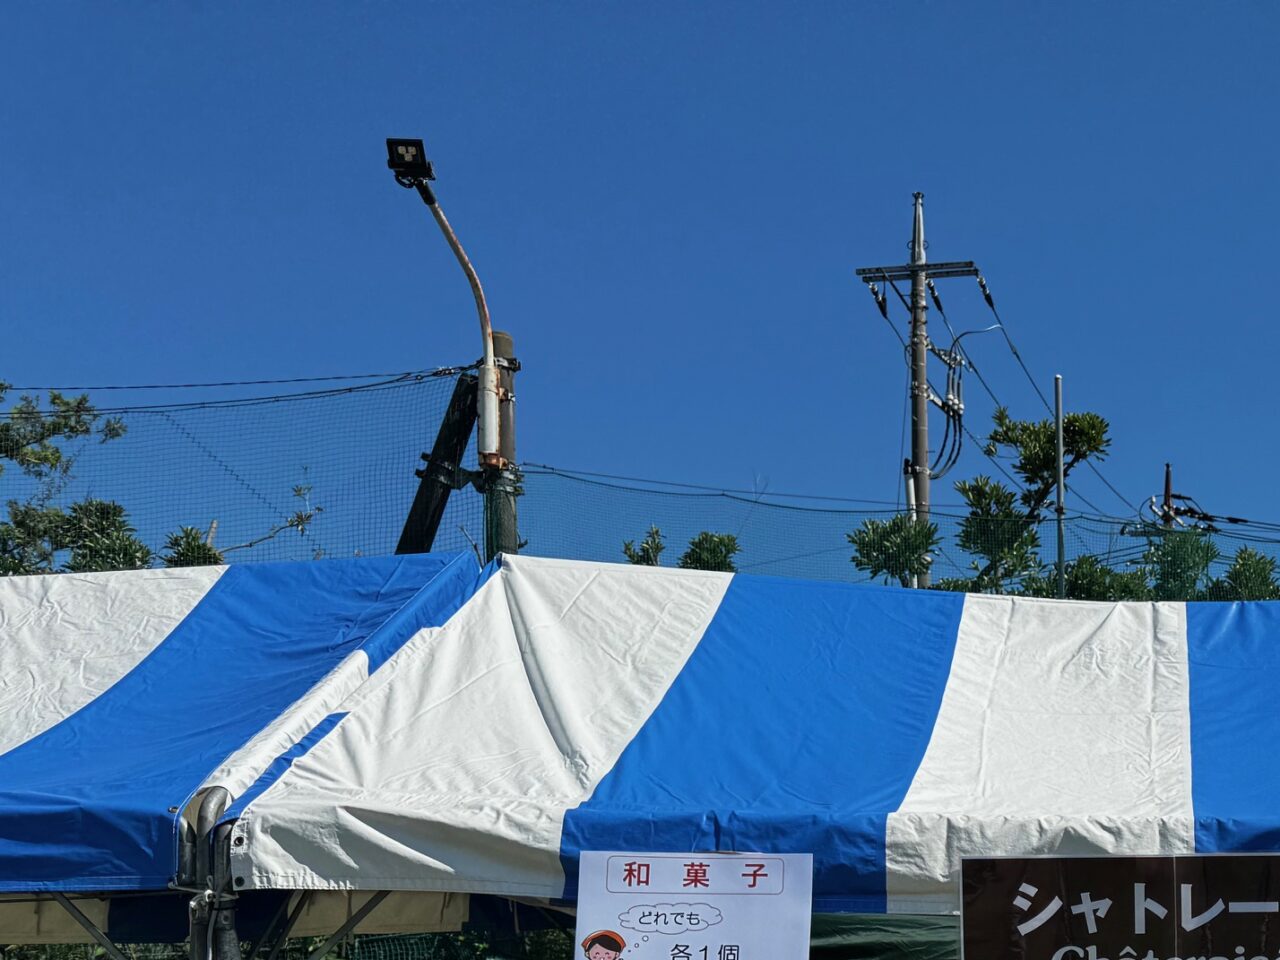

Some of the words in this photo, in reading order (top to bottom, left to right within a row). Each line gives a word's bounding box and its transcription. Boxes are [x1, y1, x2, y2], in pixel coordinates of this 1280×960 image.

[623, 861, 768, 888] 和菓子
[638, 911, 701, 926] どれでも
